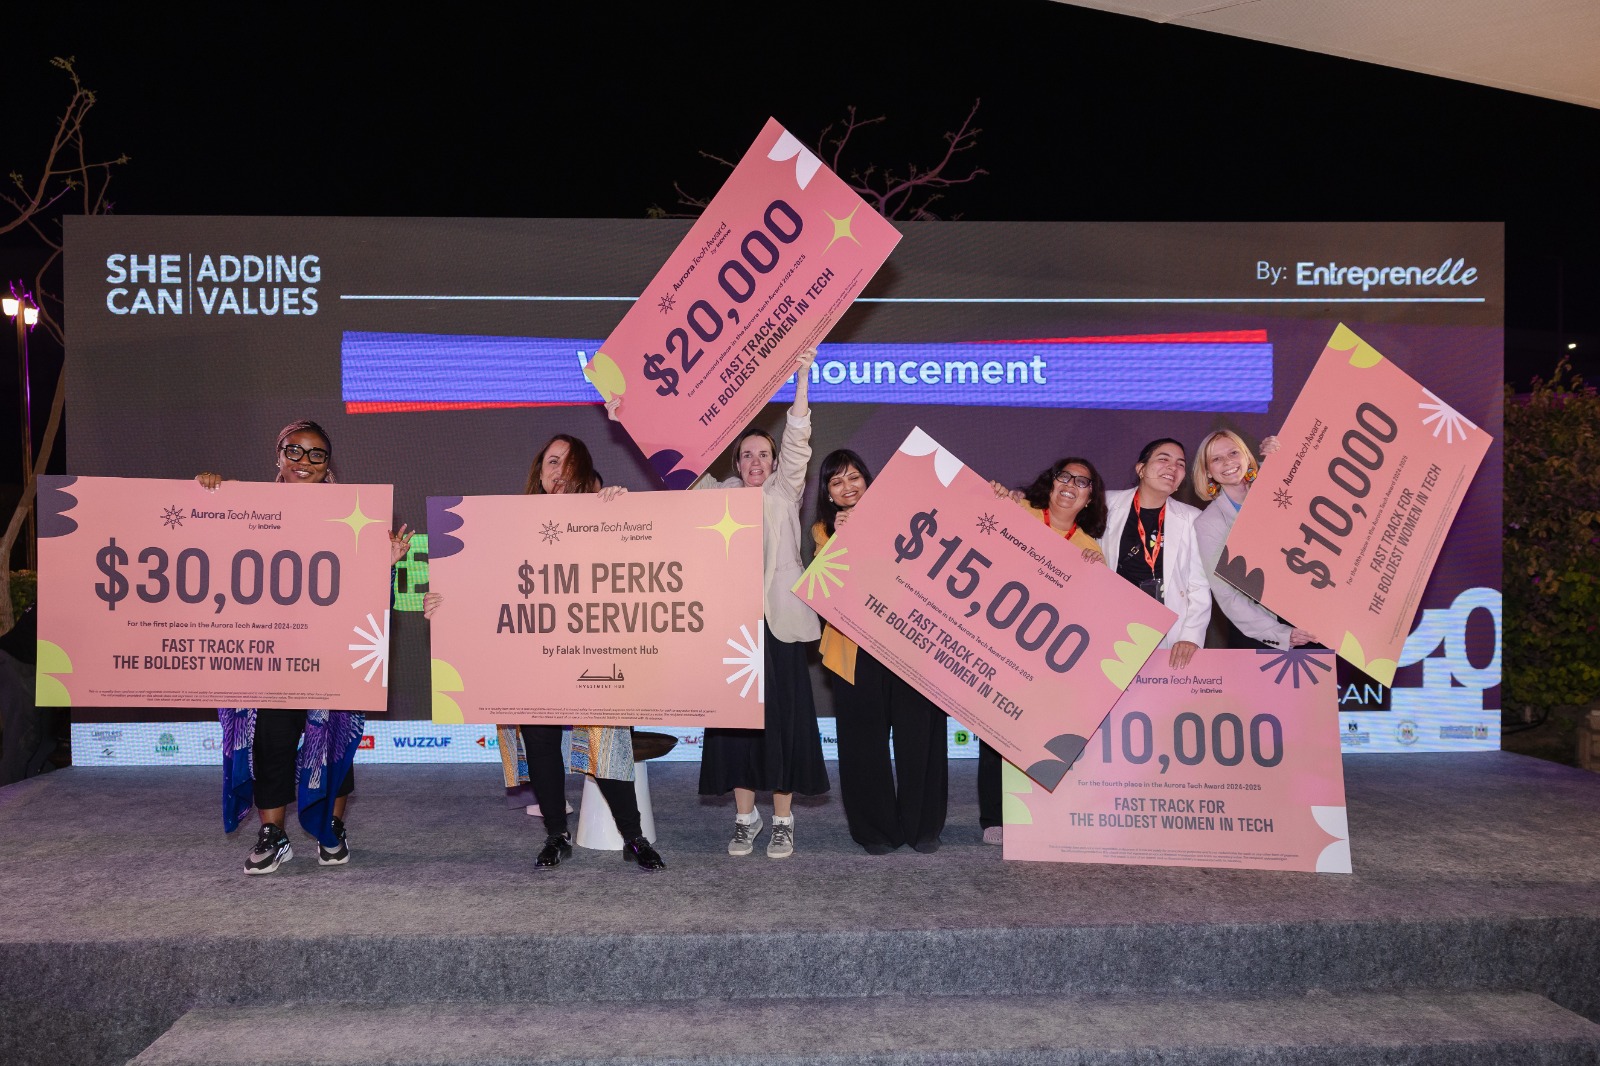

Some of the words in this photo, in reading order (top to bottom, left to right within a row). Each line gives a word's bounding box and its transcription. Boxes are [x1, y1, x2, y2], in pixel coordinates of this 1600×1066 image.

[106, 253, 181, 284] SHE
[197, 254, 321, 283] ADDING
[672, 264, 696, 292] Aurora
[692, 246, 709, 266] Tech
[705, 221, 727, 249] Award
[1256, 261, 1287, 285] By:
[1296, 257, 1478, 292] Entreprenelle
[106, 288, 183, 315] CAN
[198, 287, 319, 316] VALUES
[643, 199, 804, 397] $20,000
[698, 402, 721, 427] THE
[717, 355, 760, 407] BOLDEST
[756, 312, 798, 359] WOMEN
[794, 298, 810, 316] IN
[805, 267, 835, 300] TECH
[719, 353, 744, 384] FAST
[741, 317, 777, 357] TRACK
[772, 295, 796, 321] FOR
[786, 354, 1047, 386] nouncement
[1282, 459, 1302, 487] Aurora
[1295, 442, 1311, 461] Tech
[1304, 417, 1323, 445] Award
[1420, 463, 1442, 492] TECH
[1280, 401, 1398, 590] $10,000
[1415, 490, 1429, 506] IN
[190, 508, 226, 520] Aurora
[227, 509, 250, 520] Tech
[250, 510, 282, 521] Award
[566, 522, 600, 533] Aurora
[600, 521, 622, 533] Tech
[622, 520, 653, 532] Award
[1369, 543, 1389, 573] FAST
[1380, 509, 1405, 546] TRACK
[1396, 487, 1415, 512] FOR
[1396, 503, 1423, 547] WOMEN
[999, 527, 1028, 552] Aurora
[1026, 546, 1046, 565] Tech
[1043, 559, 1072, 583] Award
[1377, 544, 1405, 595] BOLDEST
[94, 537, 341, 615] $30,000
[517, 559, 580, 600] $1M
[591, 560, 684, 594] PERKS
[894, 508, 1091, 674] $15,000
[496, 603, 556, 634] AND
[567, 600, 705, 634] SERVICES
[1368, 591, 1386, 615] THE
[152, 620, 168, 628] first
[168, 620, 189, 629] place
[210, 621, 234, 629] Aurora
[234, 621, 251, 629] Tech
[251, 622, 273, 630] Award
[274, 622, 309, 630] 2024-2025
[162, 638, 196, 653] FAST
[198, 638, 245, 654] TRACK
[248, 639, 275, 654] FOR
[542, 645, 555, 658] by
[556, 645, 581, 655] Falak
[582, 645, 638, 655] Investment
[639, 644, 659, 655] Hub
[864, 593, 889, 619] THE
[885, 611, 937, 654] BOLDEST
[933, 647, 980, 688] WOMEN
[976, 681, 994, 699] IN
[991, 691, 1024, 721] TECH
[907, 608, 939, 635] FAST
[935, 628, 975, 664] TRACK
[971, 657, 997, 682] FOR
[112, 654, 140, 670] THE
[144, 655, 206, 671] BOLDEST
[209, 656, 264, 672] WOMEN
[268, 657, 282, 672] IN
[285, 657, 320, 673] TECH
[1135, 675, 1169, 685] Aurora
[1170, 675, 1192, 685] Tech
[1192, 675, 1223, 686] Award
[1337, 683, 1383, 705] AN
[393, 737, 451, 747] WUZZUF
[1068, 711, 1284, 775] 10,000
[1123, 780, 1143, 788] place
[1163, 781, 1186, 789] Aurora
[1203, 782, 1225, 790] Award
[1226, 783, 1262, 791] 2024-2025
[1114, 797, 1146, 812] FAST
[1149, 798, 1195, 814] TRACK
[1198, 799, 1226, 814] FOR
[1069, 812, 1094, 827] THE
[1098, 813, 1158, 829] BOLDEST
[1160, 815, 1215, 831] WOMEN
[1219, 816, 1234, 832] IN
[1237, 817, 1274, 833] TECH
